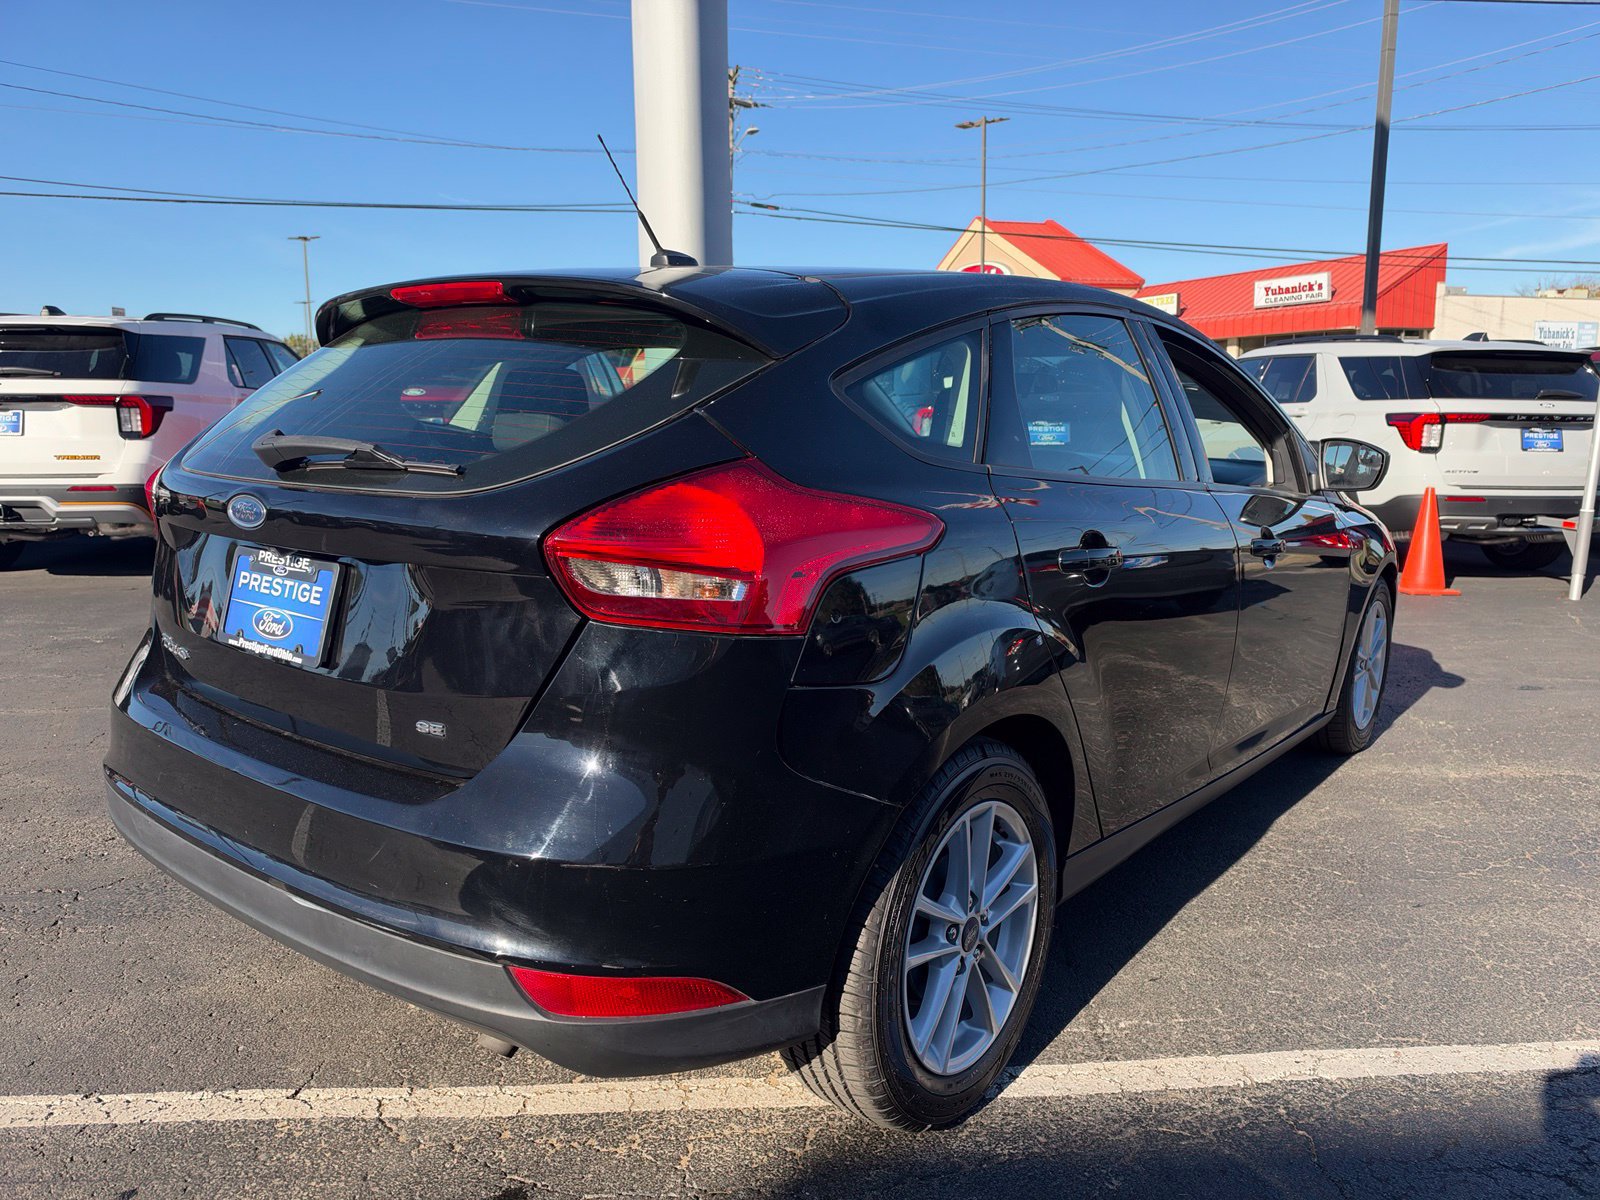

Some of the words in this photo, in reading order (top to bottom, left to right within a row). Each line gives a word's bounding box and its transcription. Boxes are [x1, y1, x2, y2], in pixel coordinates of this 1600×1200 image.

[1264, 280, 1323, 297] Yuhanick's
[1264, 294, 1303, 304] CLEANING
[1305, 292, 1323, 300] FAIR
[1539, 327, 1575, 340] Yuhanick's
[258, 550, 311, 570] PRESTIGE
[238, 571, 323, 605] PRESTIGE
[258, 610, 287, 636] Ford
[228, 638, 303, 664] www.PrestigeFordOhio.com
